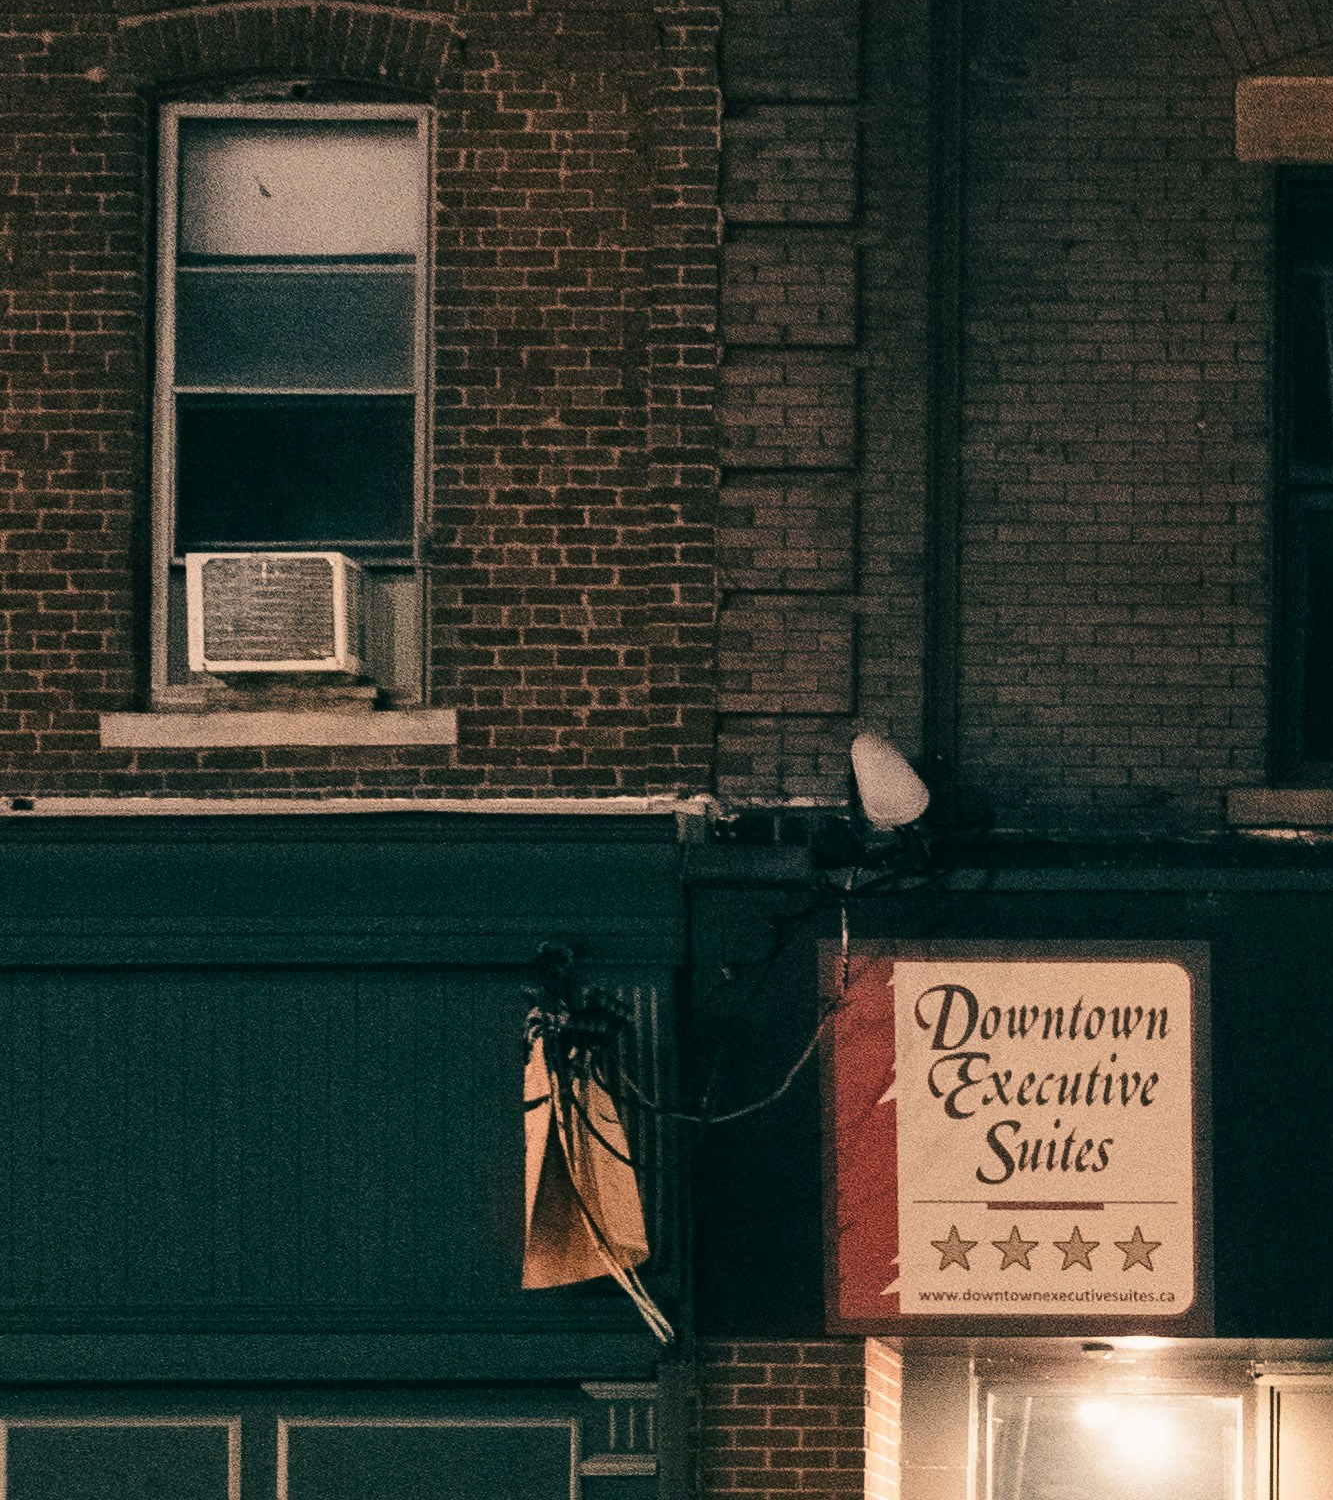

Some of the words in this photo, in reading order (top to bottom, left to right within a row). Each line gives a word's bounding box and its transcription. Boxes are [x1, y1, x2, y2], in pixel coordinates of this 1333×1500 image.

[915, 984, 1169, 1051] Downtown
[927, 1052, 1159, 1119] Executive
[975, 1119, 1113, 1185] Suites
[919, 1288, 1176, 1304] www.downtownexecutivesuites.ca
